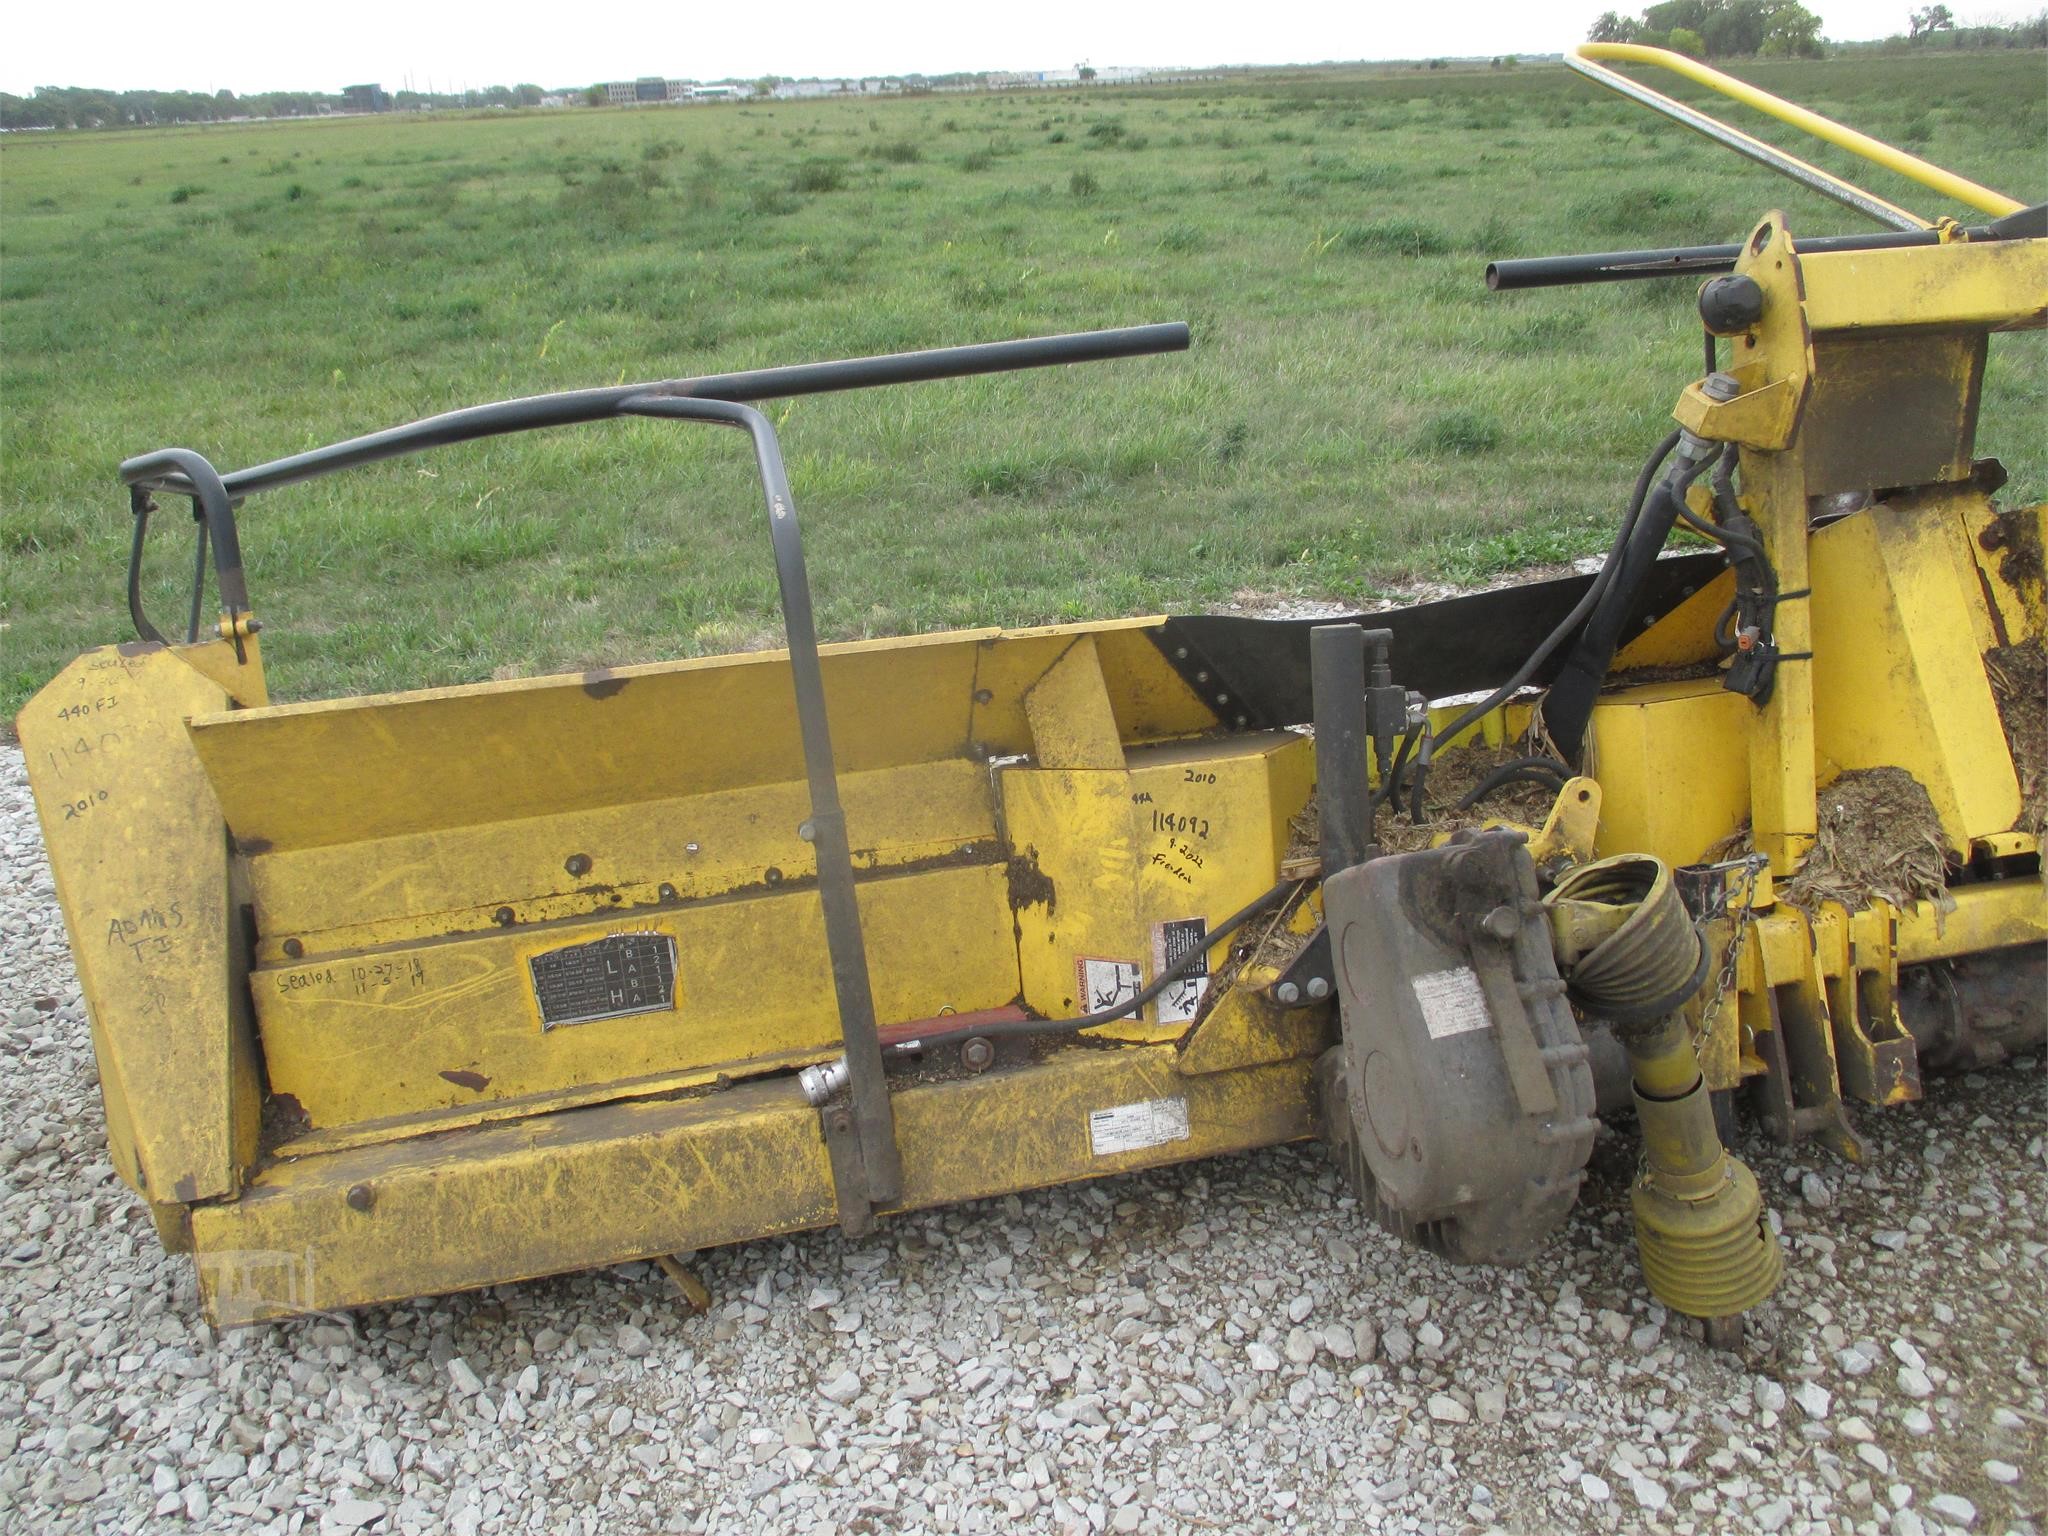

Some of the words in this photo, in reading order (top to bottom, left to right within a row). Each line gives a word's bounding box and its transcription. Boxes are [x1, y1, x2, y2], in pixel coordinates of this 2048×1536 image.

[57, 704, 90, 721] 440
[1184, 769, 1216, 785] 2010
[61, 789, 108, 820] 2010
[1152, 809, 1210, 840] 114092
[625, 949, 633, 959] B
[653, 955, 660, 965] 2
[606, 959, 618, 975] L
[628, 964, 637, 974] A
[276, 968, 337, 994] Sealed
[630, 979, 639, 989] B
[1077, 959, 1086, 1001] WARNING
[610, 988, 624, 1005] H
[658, 985, 665, 994] 2
[632, 993, 642, 1004] A
